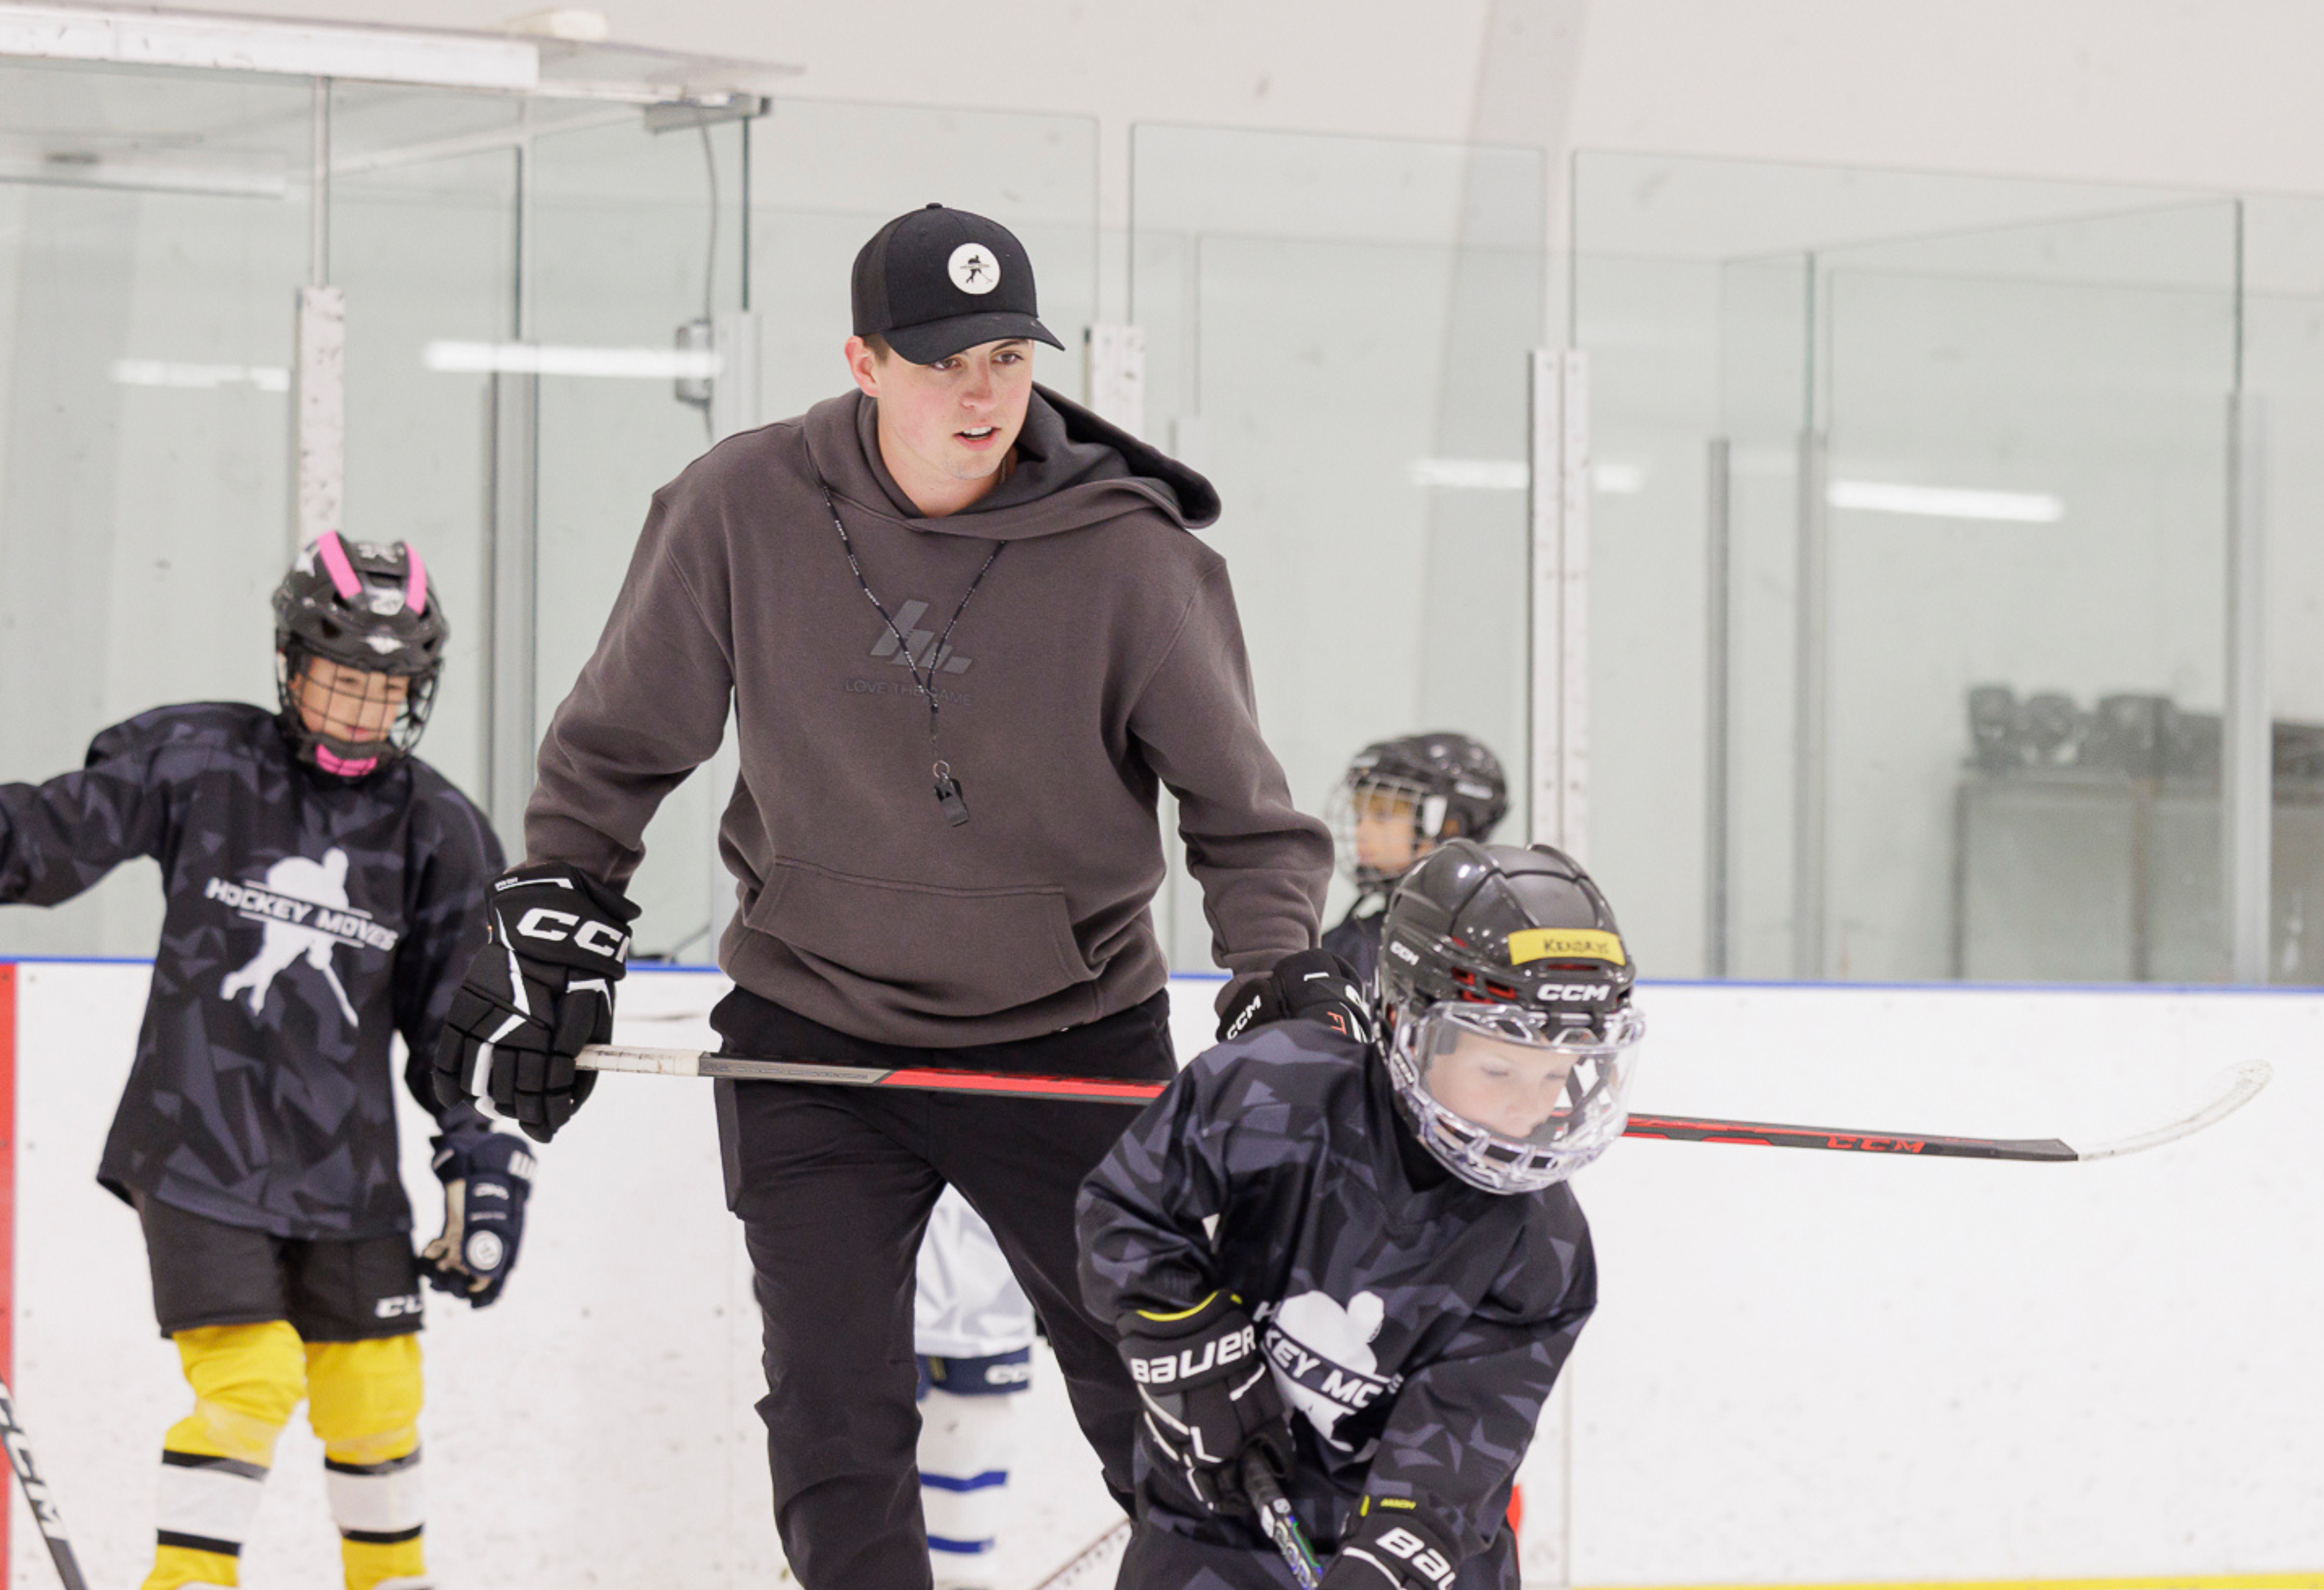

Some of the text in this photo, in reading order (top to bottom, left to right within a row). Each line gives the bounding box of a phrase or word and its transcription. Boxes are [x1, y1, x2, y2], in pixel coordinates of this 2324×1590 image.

[846, 679, 887, 694] LOVE
[891, 683, 922, 697] THE
[203, 876, 399, 951] HOCKEY MOVES
[1389, 940, 1420, 966] CCM
[1537, 984, 1611, 1002] CCM
[1227, 995, 1263, 1040] CCM
[1826, 1136, 1926, 1154] CCM
[374, 1295, 424, 1318] CC
[985, 1362, 1029, 1384] CC
